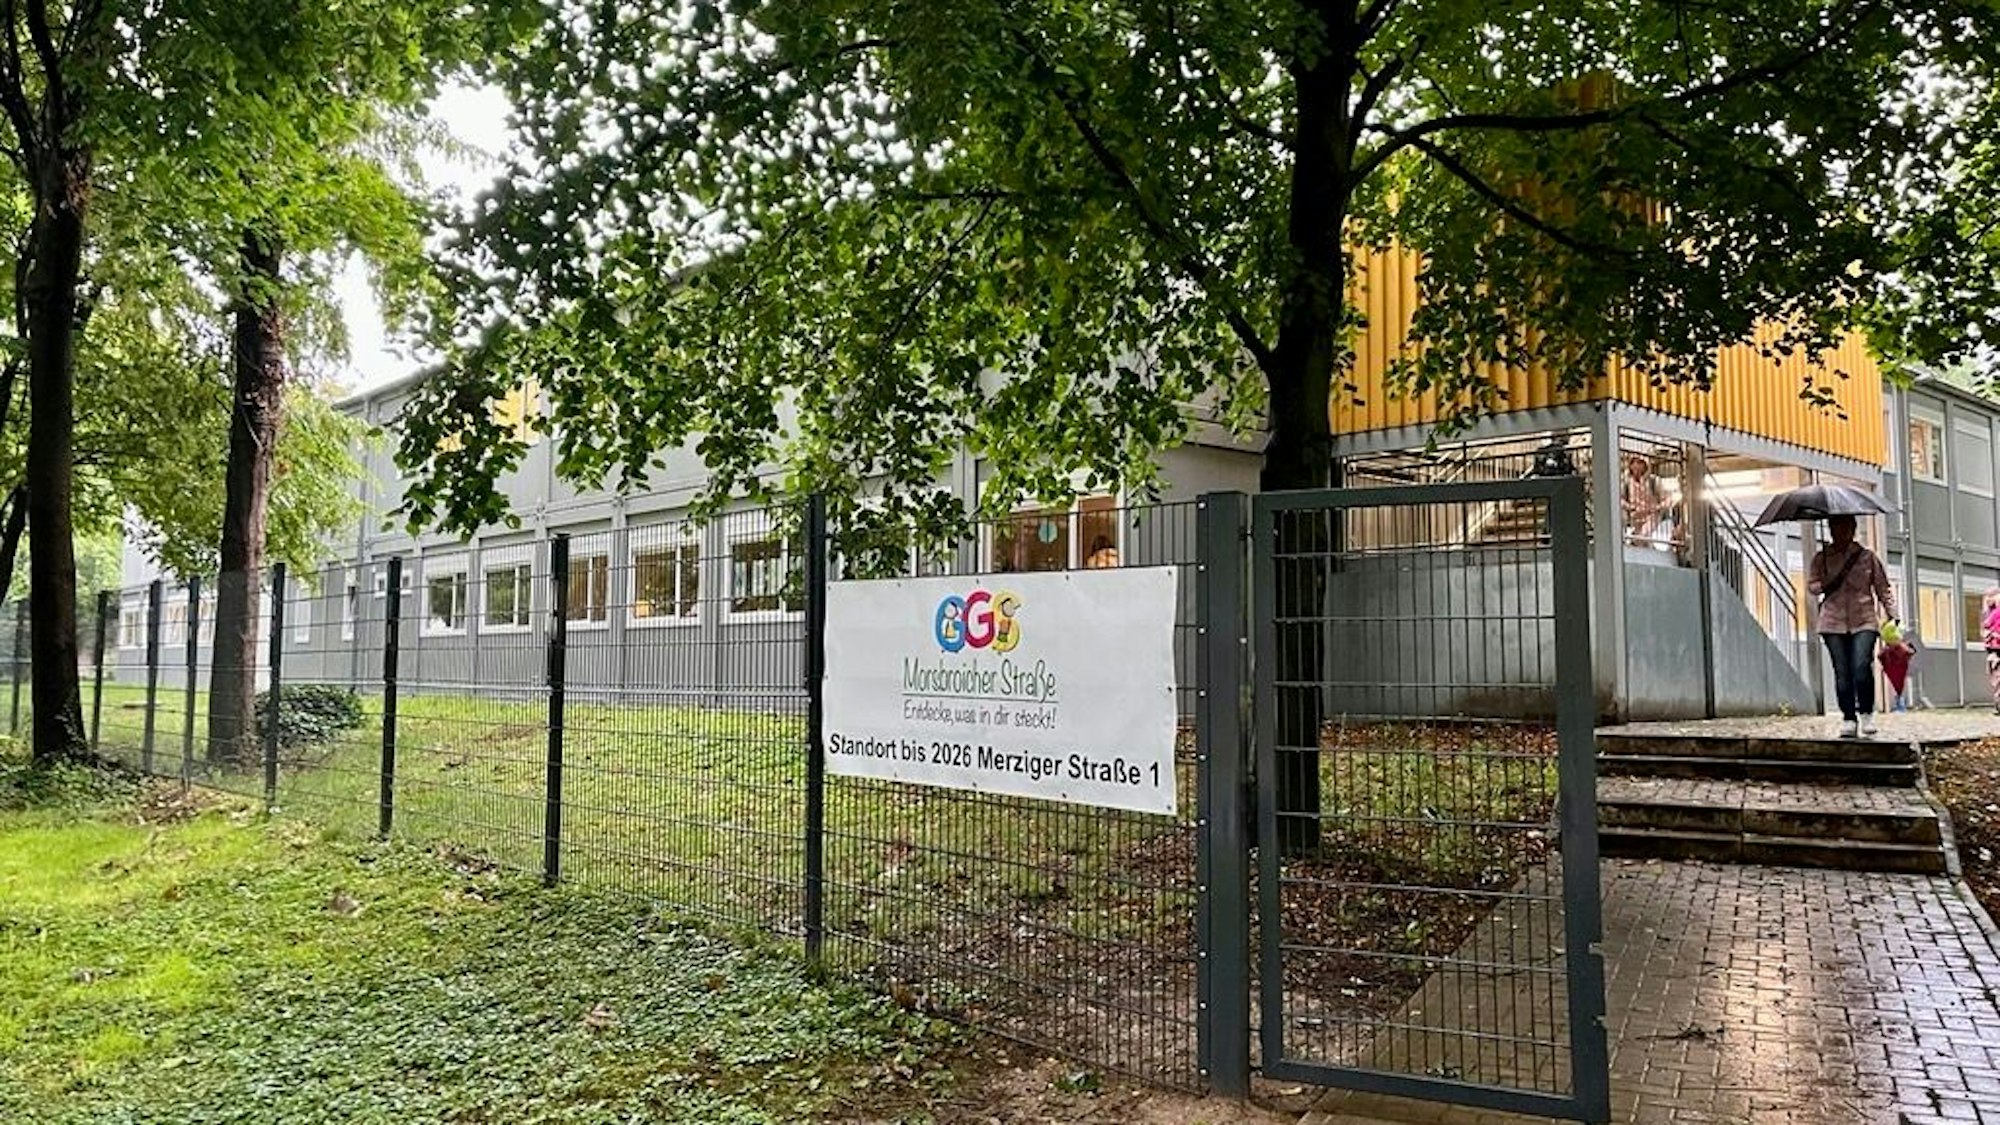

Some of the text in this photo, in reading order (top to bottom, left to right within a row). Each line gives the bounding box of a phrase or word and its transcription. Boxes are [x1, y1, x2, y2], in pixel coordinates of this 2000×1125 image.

[932, 590, 1022, 654] GGS
[1001, 659, 1056, 703] Straße
[980, 702, 991, 725] in
[994, 704, 1009, 725] dir
[1015, 708, 1056, 729] steckt!
[829, 733, 1160, 787] Standort bis 2026 Merziger Straße 1
